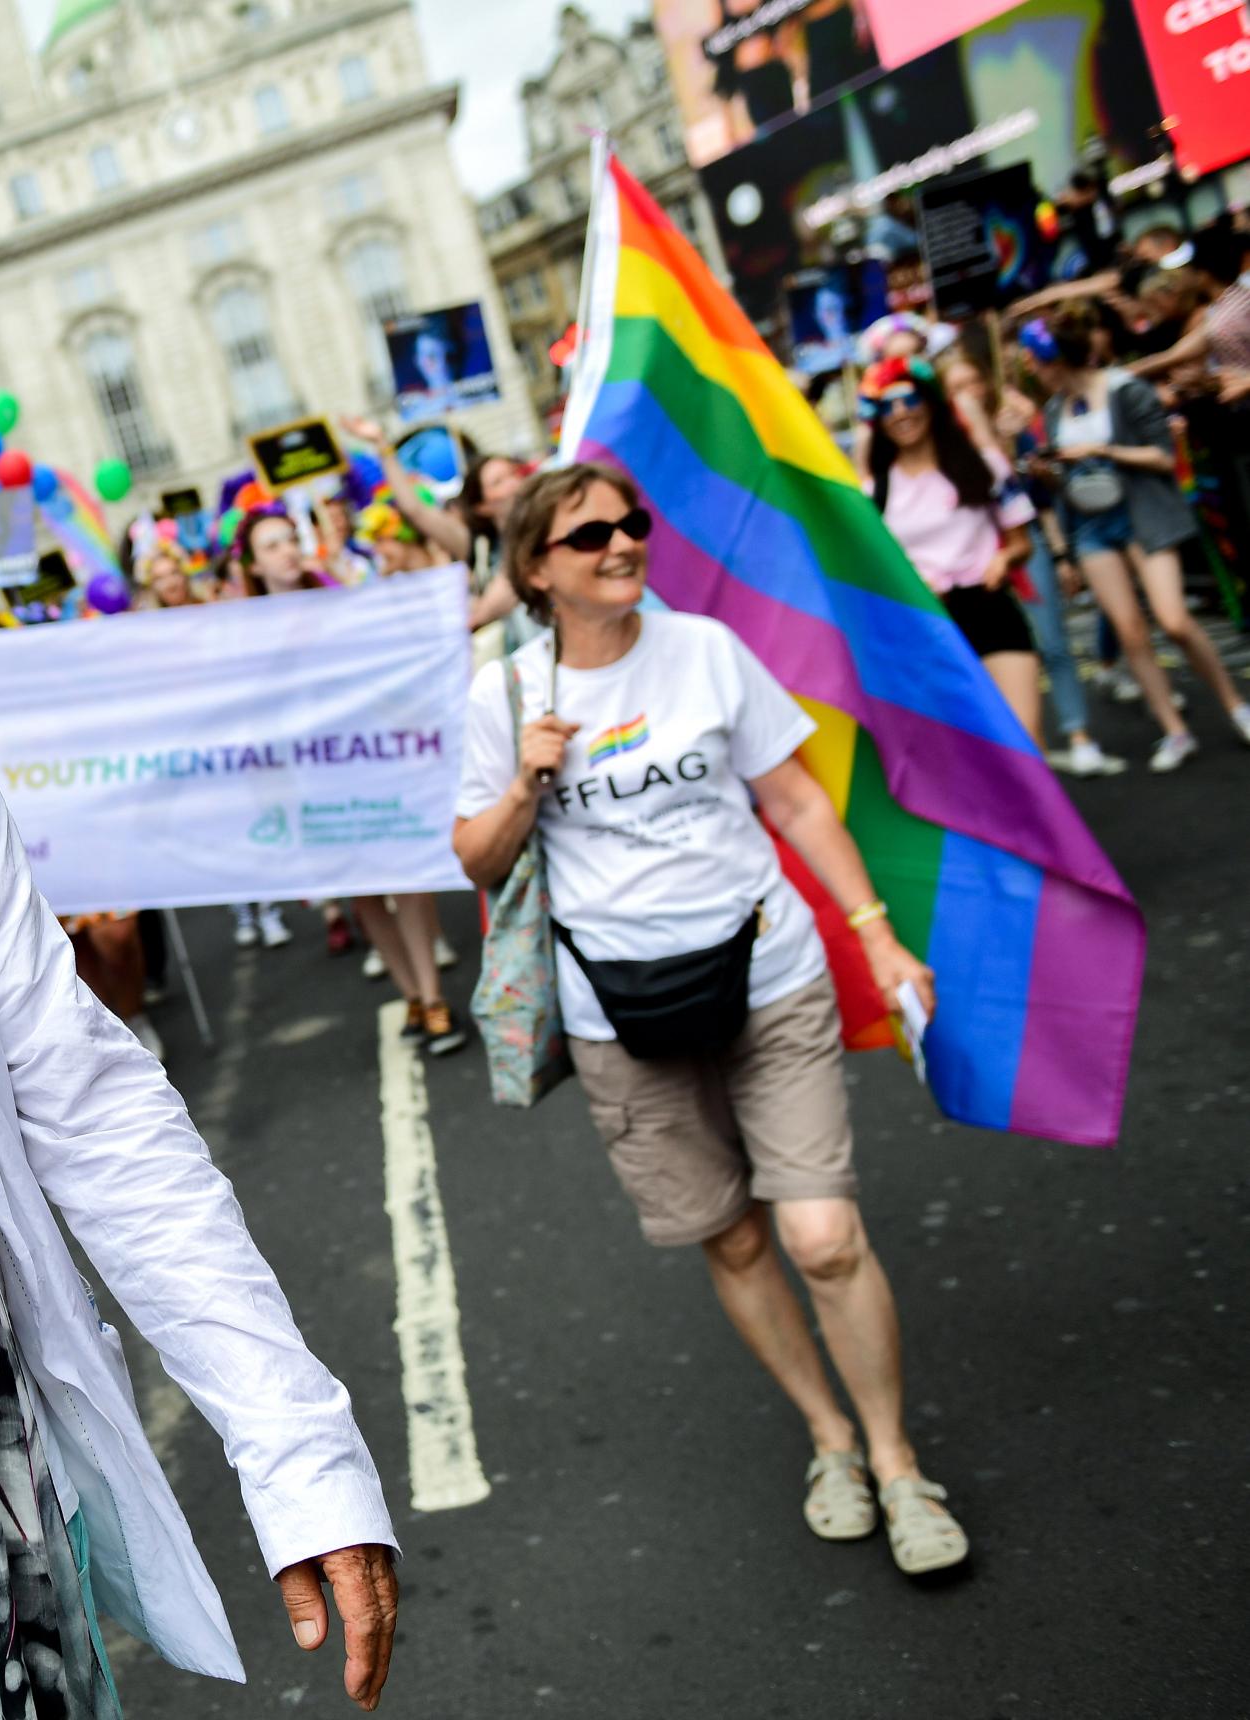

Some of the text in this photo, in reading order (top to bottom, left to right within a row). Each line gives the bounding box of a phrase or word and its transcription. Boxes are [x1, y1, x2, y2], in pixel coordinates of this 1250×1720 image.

[3, 729, 443, 789] YOUTH MENTAL HEALTH
[554, 752, 708, 815] FFLAG
